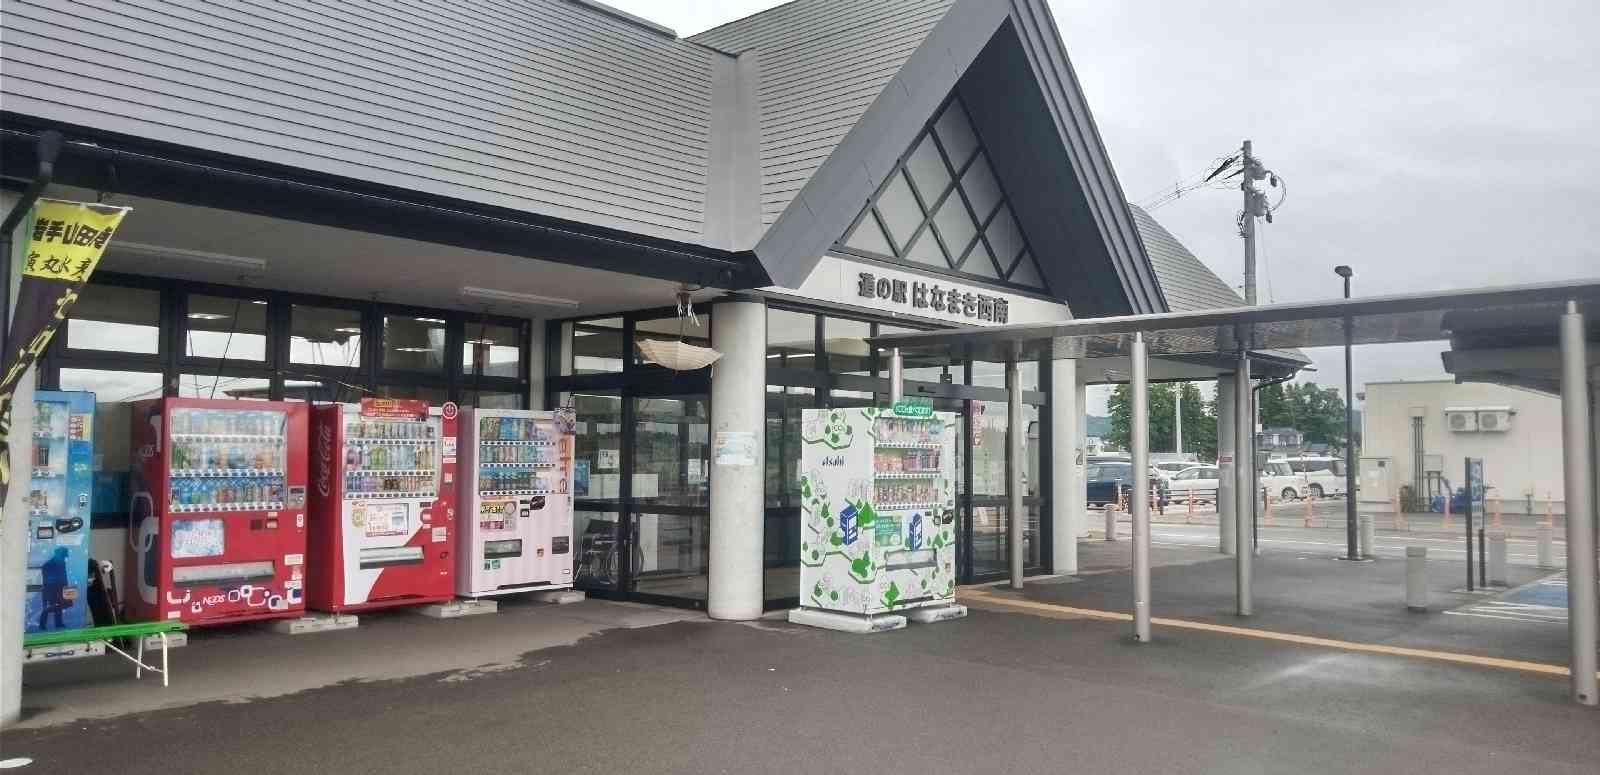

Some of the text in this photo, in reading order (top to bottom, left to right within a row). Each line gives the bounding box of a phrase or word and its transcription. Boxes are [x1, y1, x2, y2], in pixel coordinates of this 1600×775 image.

[857, 272, 1009, 324] 道の駅 はなまき西南
